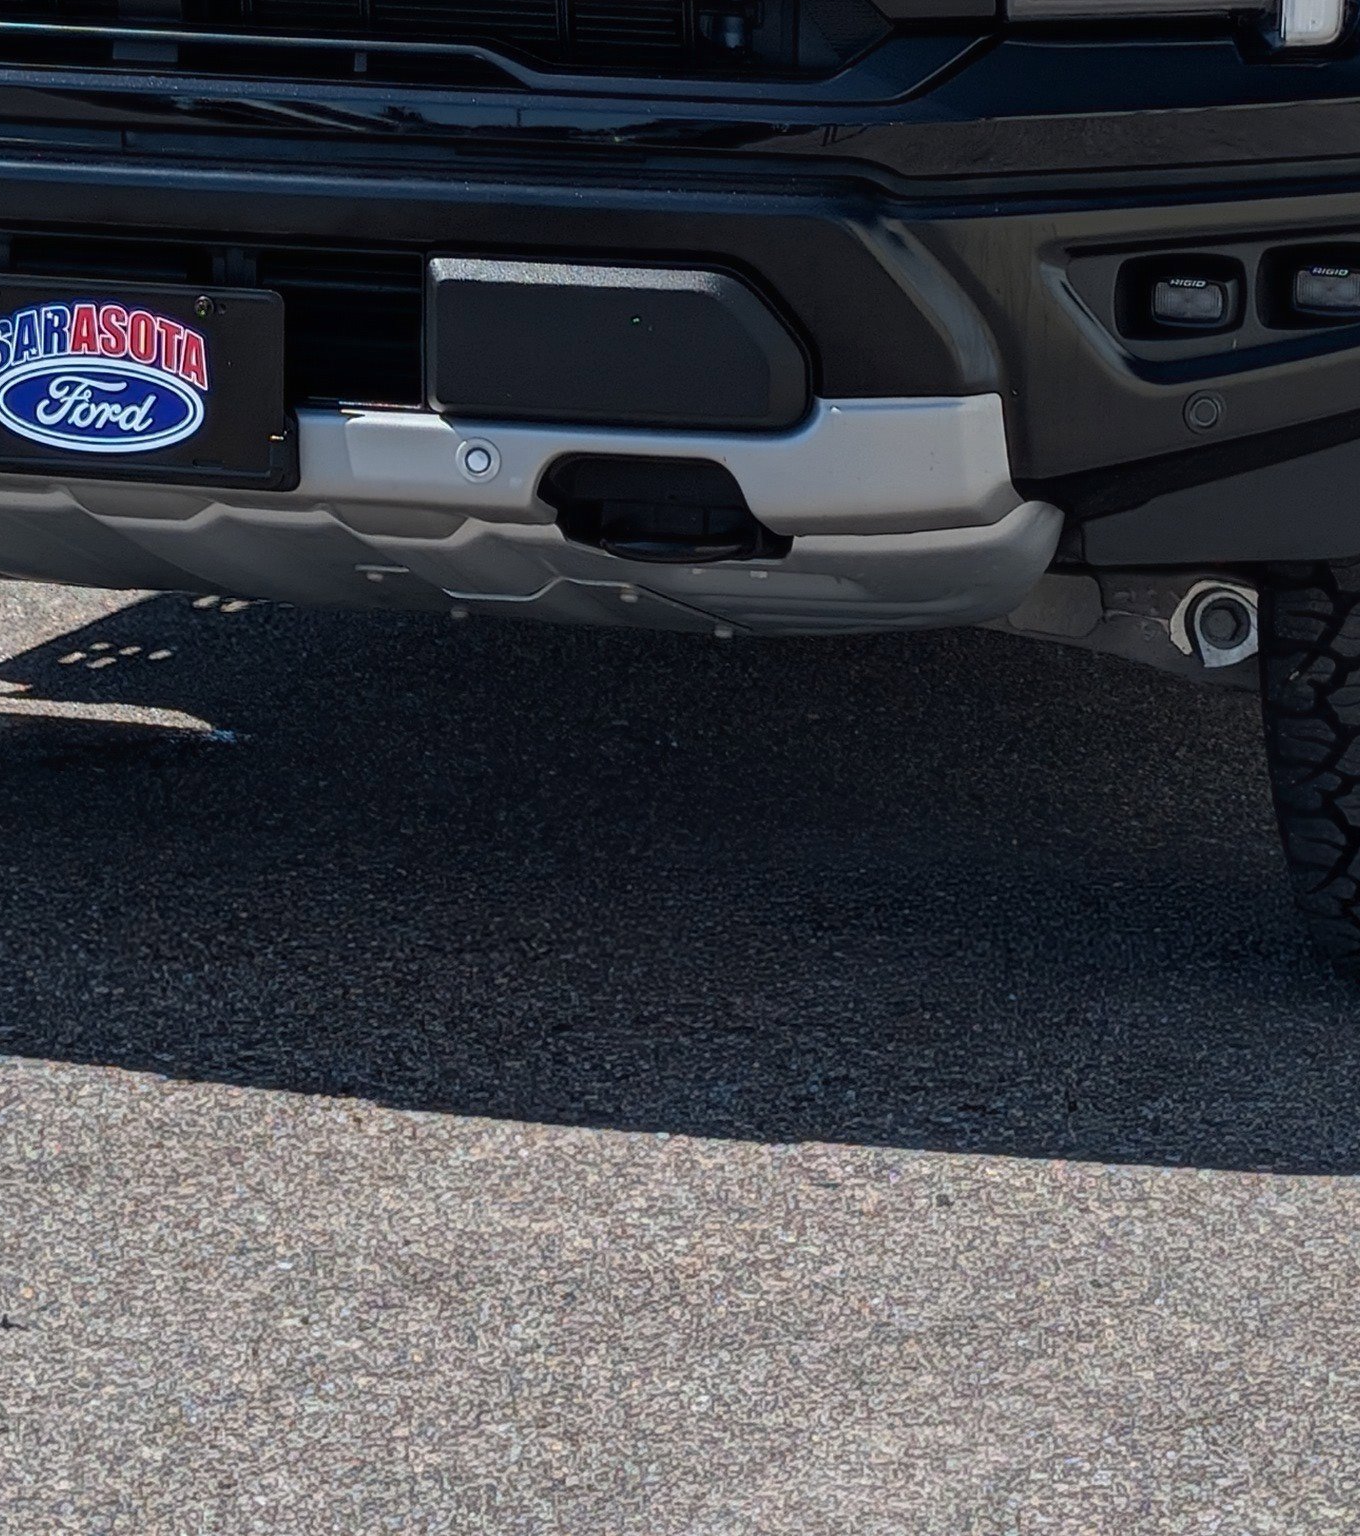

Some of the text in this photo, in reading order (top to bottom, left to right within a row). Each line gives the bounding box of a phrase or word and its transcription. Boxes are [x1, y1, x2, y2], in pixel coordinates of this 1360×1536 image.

[1312, 267, 1349, 276] RIGID
[1170, 278, 1207, 288] RIGID
[36, 375, 156, 432] Ford
